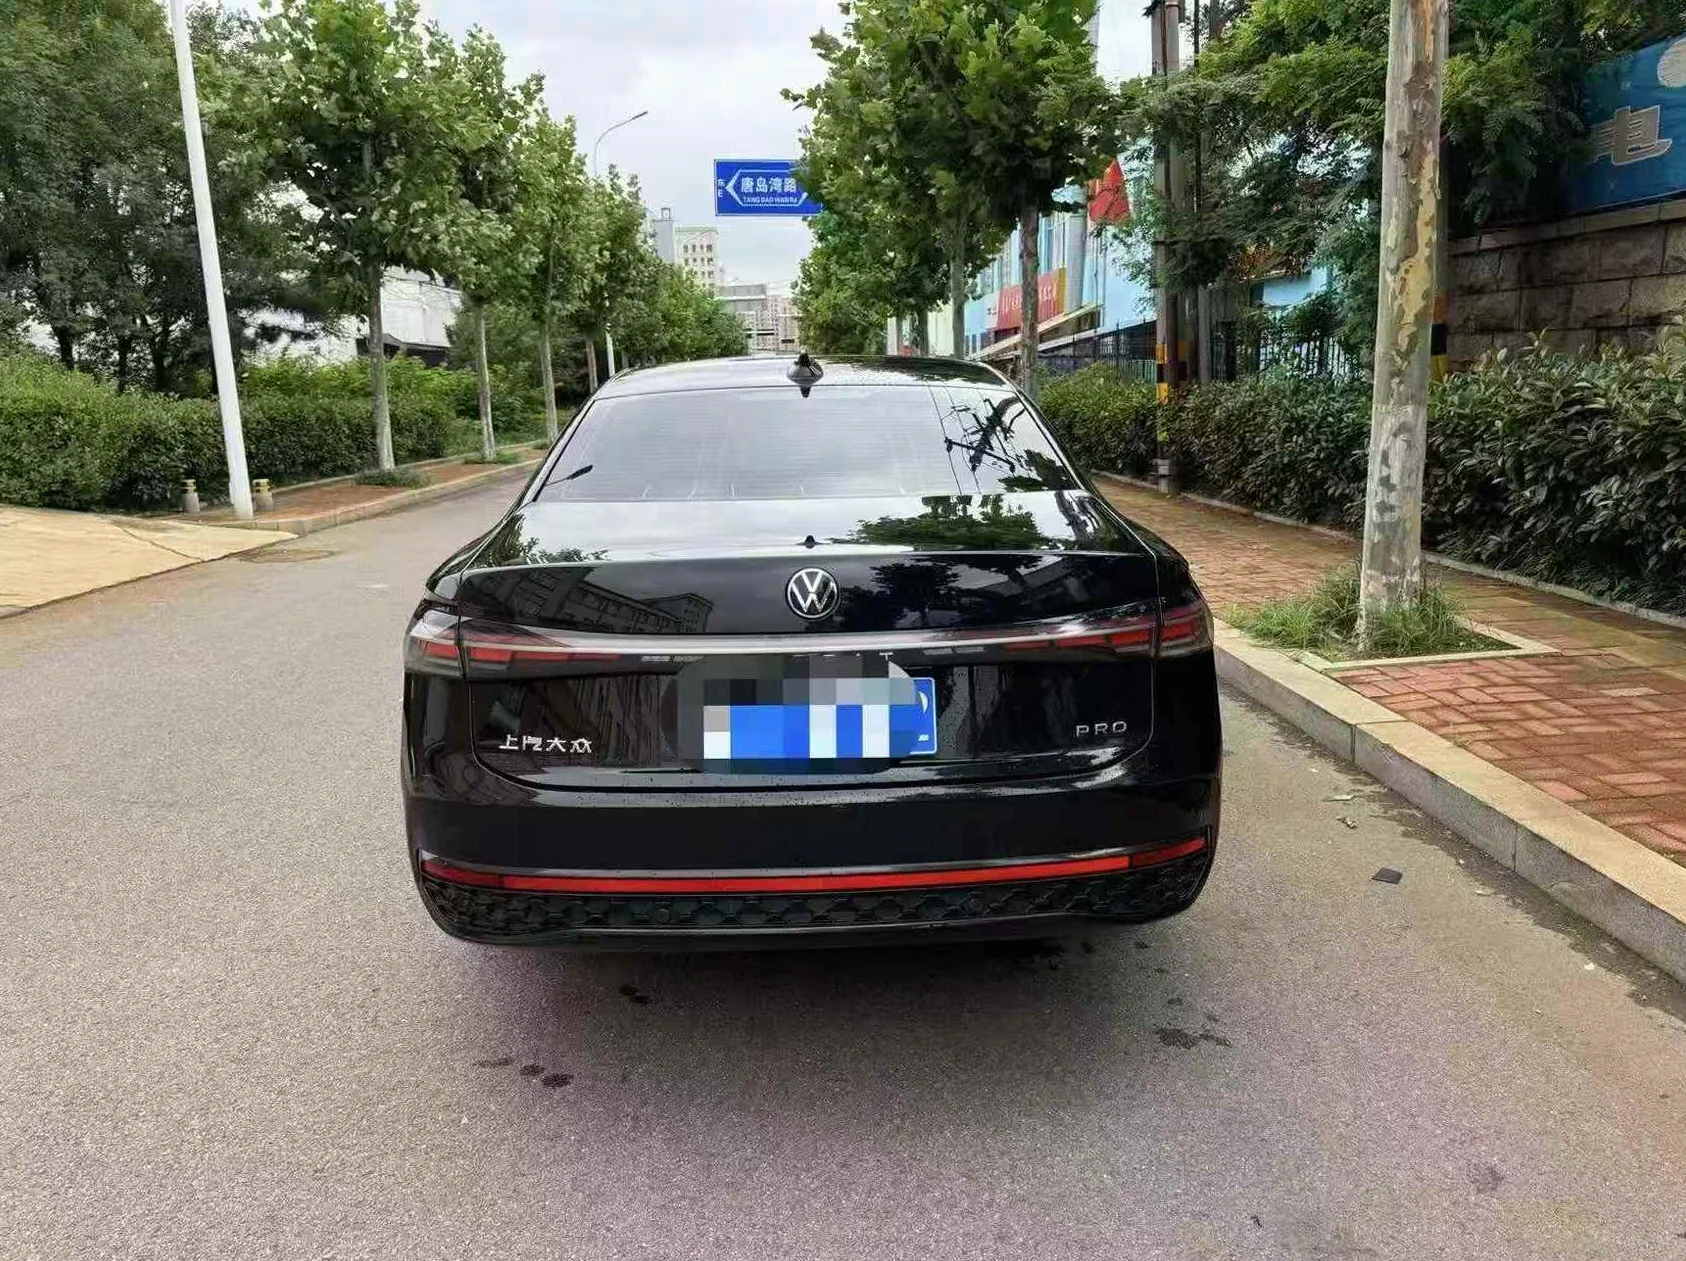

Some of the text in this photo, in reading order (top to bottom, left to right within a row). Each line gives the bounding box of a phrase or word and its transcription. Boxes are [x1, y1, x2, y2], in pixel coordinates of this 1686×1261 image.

[1591, 104, 1674, 167] 电
[741, 176, 797, 193] 唐岛湾路
[1076, 721, 1127, 737] PRO
[498, 734, 592, 753] 上汽大众
